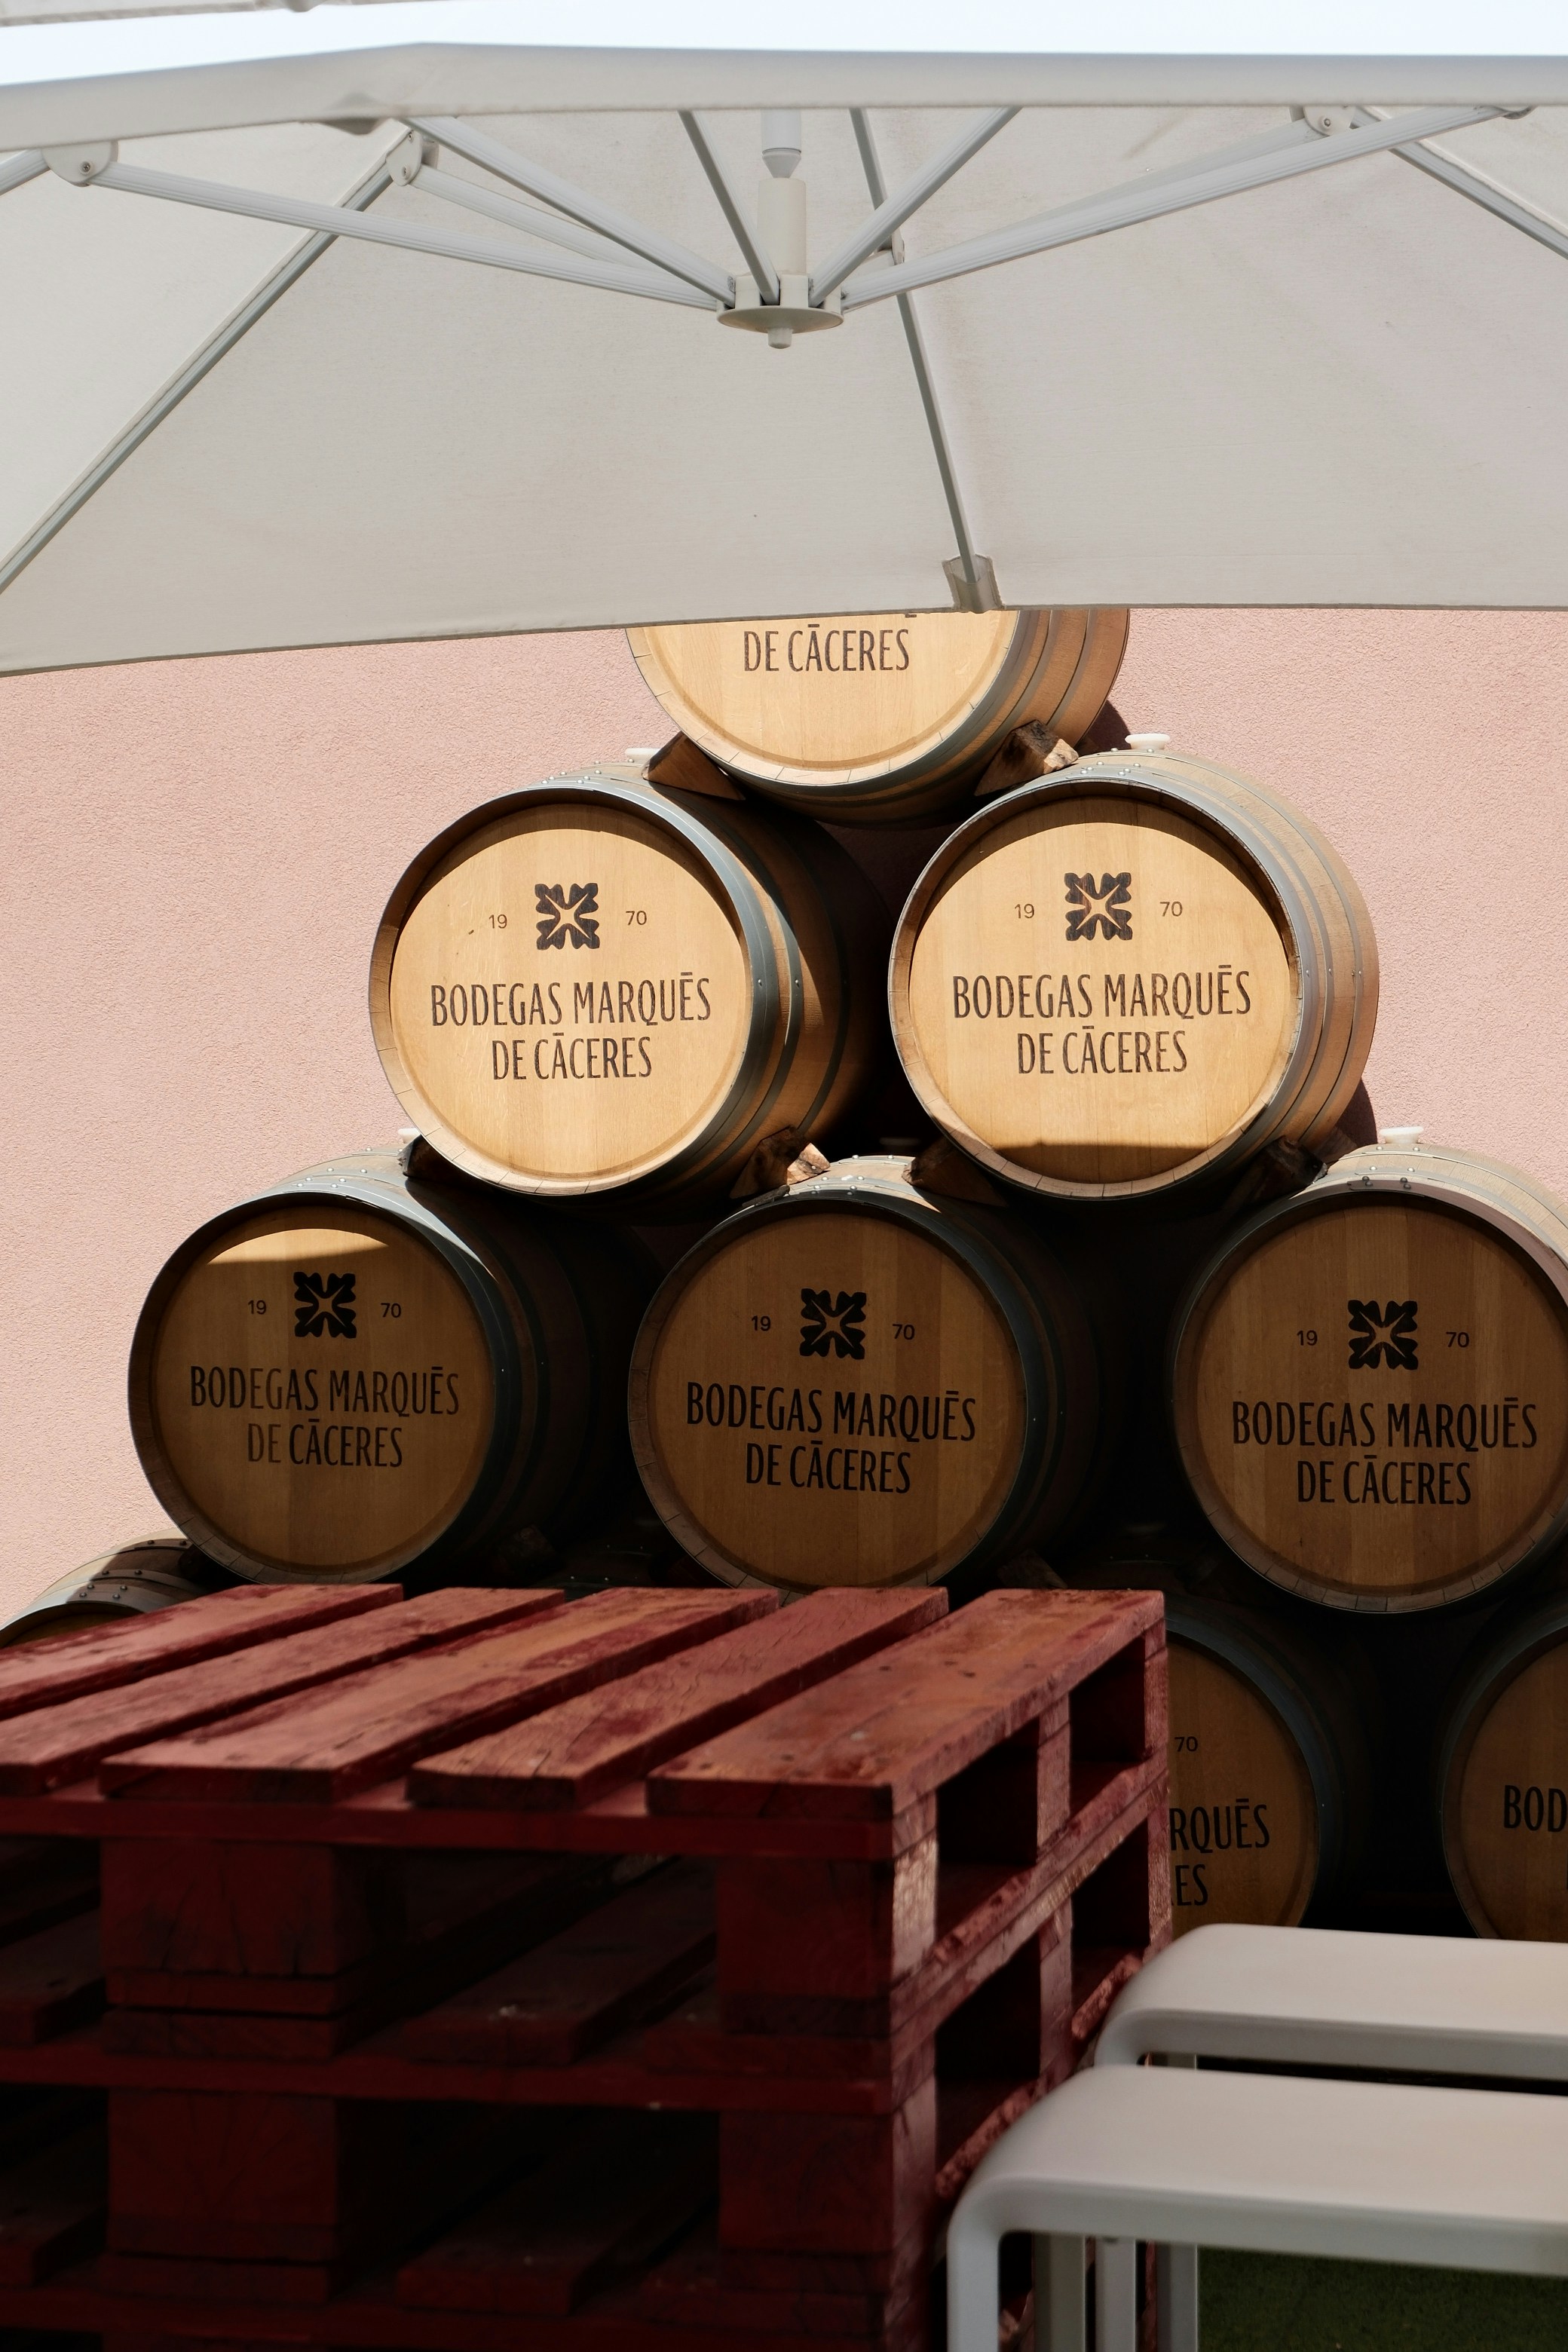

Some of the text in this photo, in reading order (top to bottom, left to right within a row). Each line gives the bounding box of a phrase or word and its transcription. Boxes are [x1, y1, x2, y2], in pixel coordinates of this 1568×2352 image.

[743, 630, 779, 672] DE
[488, 910, 648, 929] 19 70
[1014, 901, 1183, 919] 19 70
[430, 982, 562, 1026] BODEGAS
[953, 974, 1092, 1018] BODEGAS
[492, 1040, 526, 1080] DE
[1017, 1032, 1054, 1074] DE
[247, 1300, 402, 1318] 19 70
[751, 1315, 915, 1340] 19 70
[1297, 1330, 1470, 1347] 19 70
[191, 1366, 318, 1411] BODEGAS
[687, 1382, 822, 1433] BODEGAS
[247, 1423, 281, 1463] DE
[1233, 1401, 1376, 1447] BODEGAS
[746, 1442, 782, 1486] DE
[1297, 1460, 1334, 1503] DE
[1174, 1736, 1198, 1752] 70
